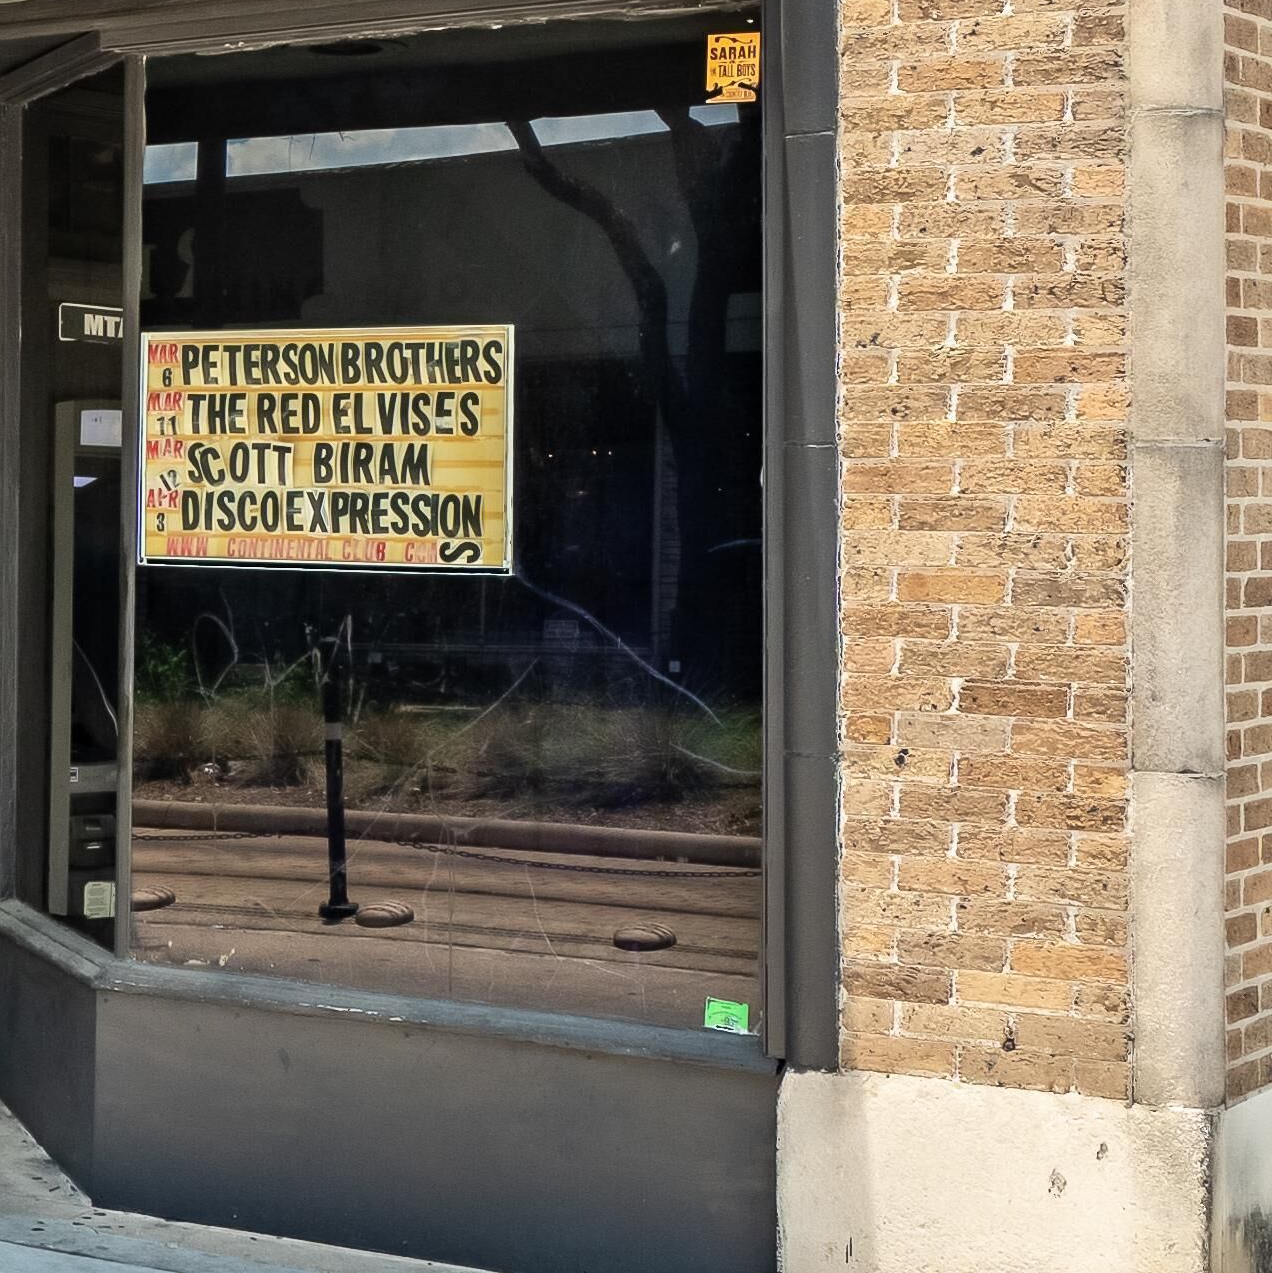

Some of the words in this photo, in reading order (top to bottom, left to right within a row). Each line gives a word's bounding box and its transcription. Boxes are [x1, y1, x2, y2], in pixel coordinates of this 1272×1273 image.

[710, 45, 756, 60] SARAH
[719, 64, 734, 77] TALL
[181, 341, 335, 386] PETERSON
[341, 339, 502, 385] BROTHERS
[162, 368, 172, 387] 6
[147, 391, 182, 412] MAR
[186, 392, 247, 435] THE
[256, 392, 321, 435] RED
[156, 416, 177, 436] 11
[147, 440, 183, 460] MAR
[187, 441, 292, 487] SCOTT
[314, 441, 432, 486] BIRAM
[159, 469, 177, 492] 12
[156, 513, 165, 532] 3
[167, 537, 208, 557] WWW
[227, 537, 332, 560] CONTINENTAL
[342, 539, 386, 562] CLUB
